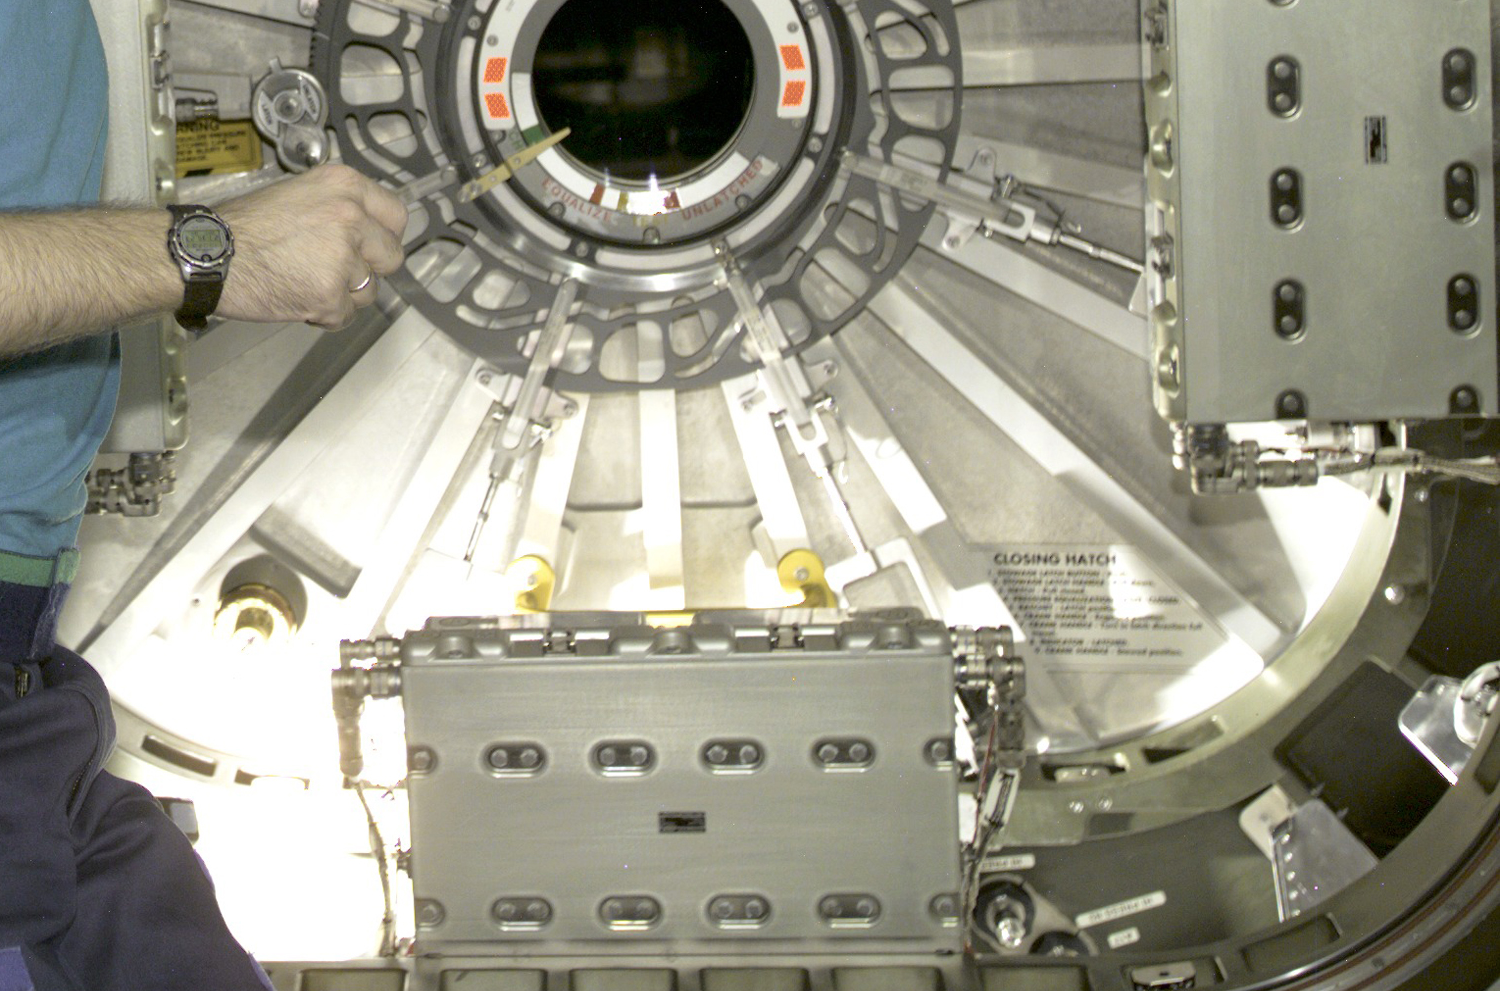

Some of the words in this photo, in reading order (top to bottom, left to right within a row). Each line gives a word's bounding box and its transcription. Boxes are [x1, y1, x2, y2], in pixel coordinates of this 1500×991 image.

[176, 118, 220, 131] RNING
[541, 176, 612, 222] EQUALIZE
[681, 159, 764, 221] UNLATCHED
[993, 553, 1060, 566] CLOSING
[1065, 553, 1116, 567] HATCH
